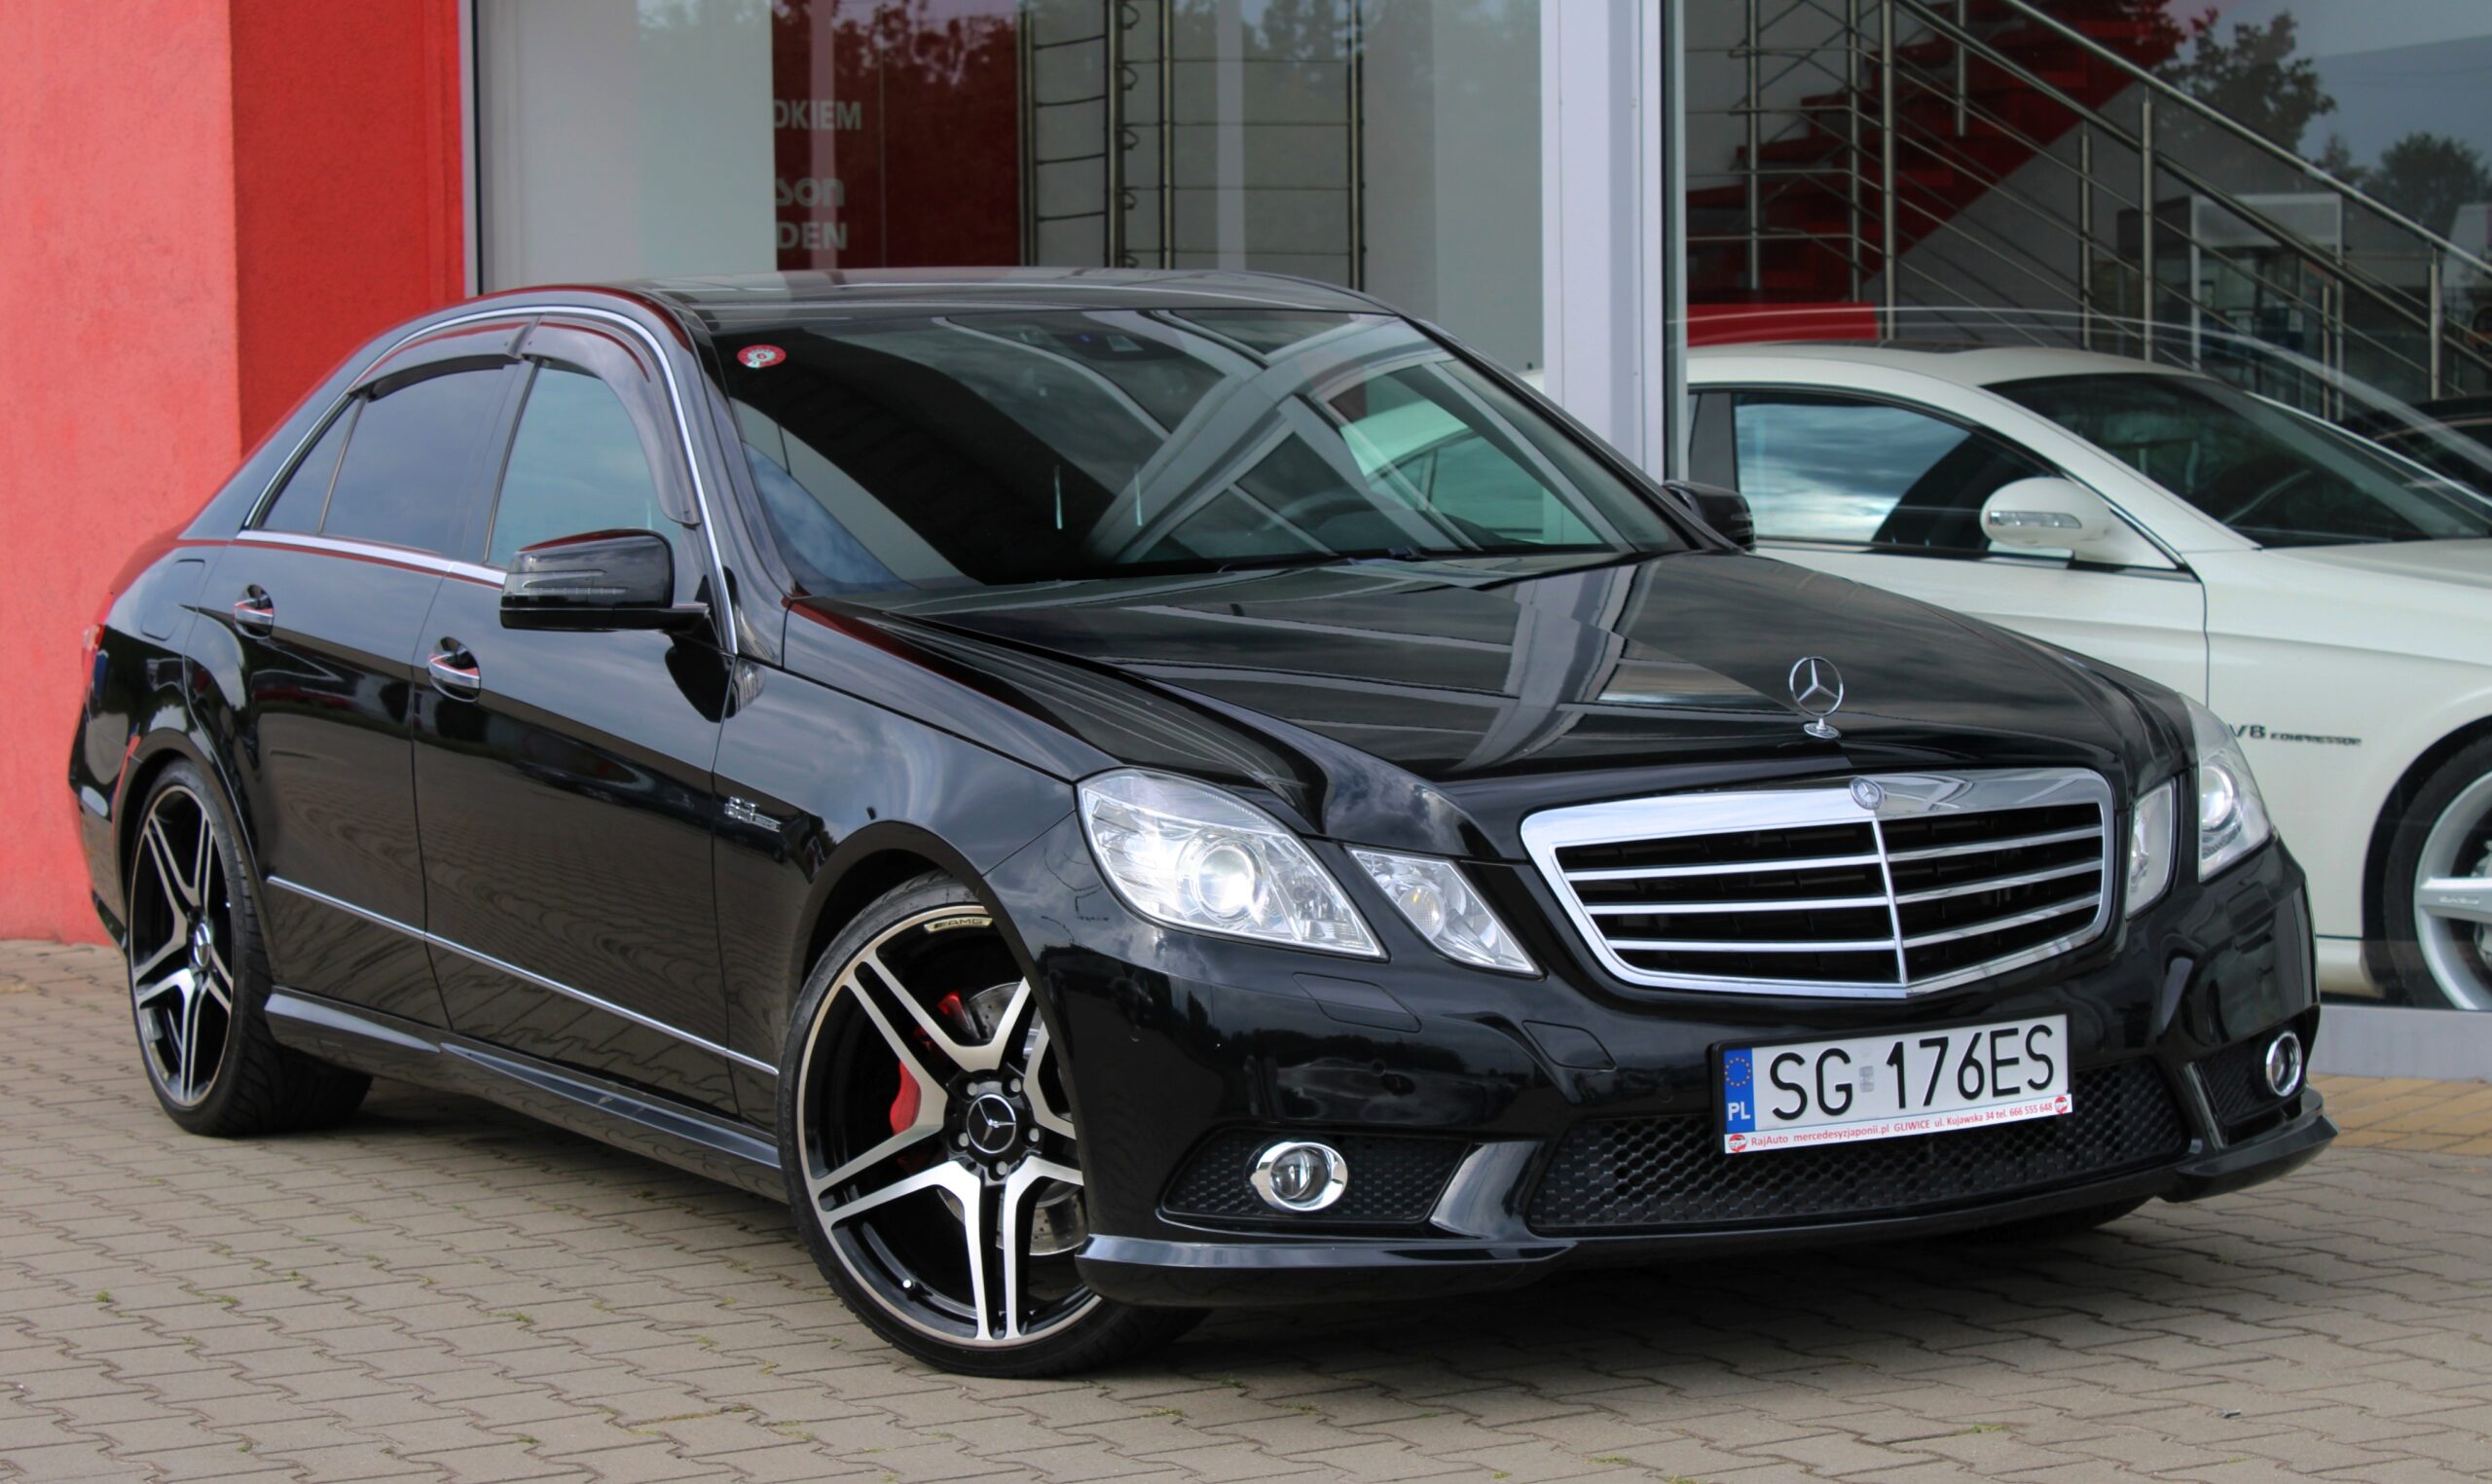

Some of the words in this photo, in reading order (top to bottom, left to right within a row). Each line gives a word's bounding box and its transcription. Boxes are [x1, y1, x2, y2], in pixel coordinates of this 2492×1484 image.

[2228, 724, 2266, 740] V8
[1770, 1047, 1853, 1121] SG
[1886, 1024, 2055, 1109] 176ES
[1728, 1102, 1751, 1121] PL
[1750, 1135, 1789, 1147] RajAuto
[1793, 1125, 1889, 1143] mercedesyzjaponii.pl
[1893, 1119, 1931, 1133] GLIWICE
[1934, 1117, 1945, 1128] ul.
[1947, 1112, 1984, 1127] Kujawska
[1985, 1110, 1995, 1121] 34
[1996, 1109, 2007, 1119] tel.
[2009, 1106, 2024, 1117] 666
[2025, 1104, 2038, 1115] 555
[2039, 1102, 2053, 1113] 648
